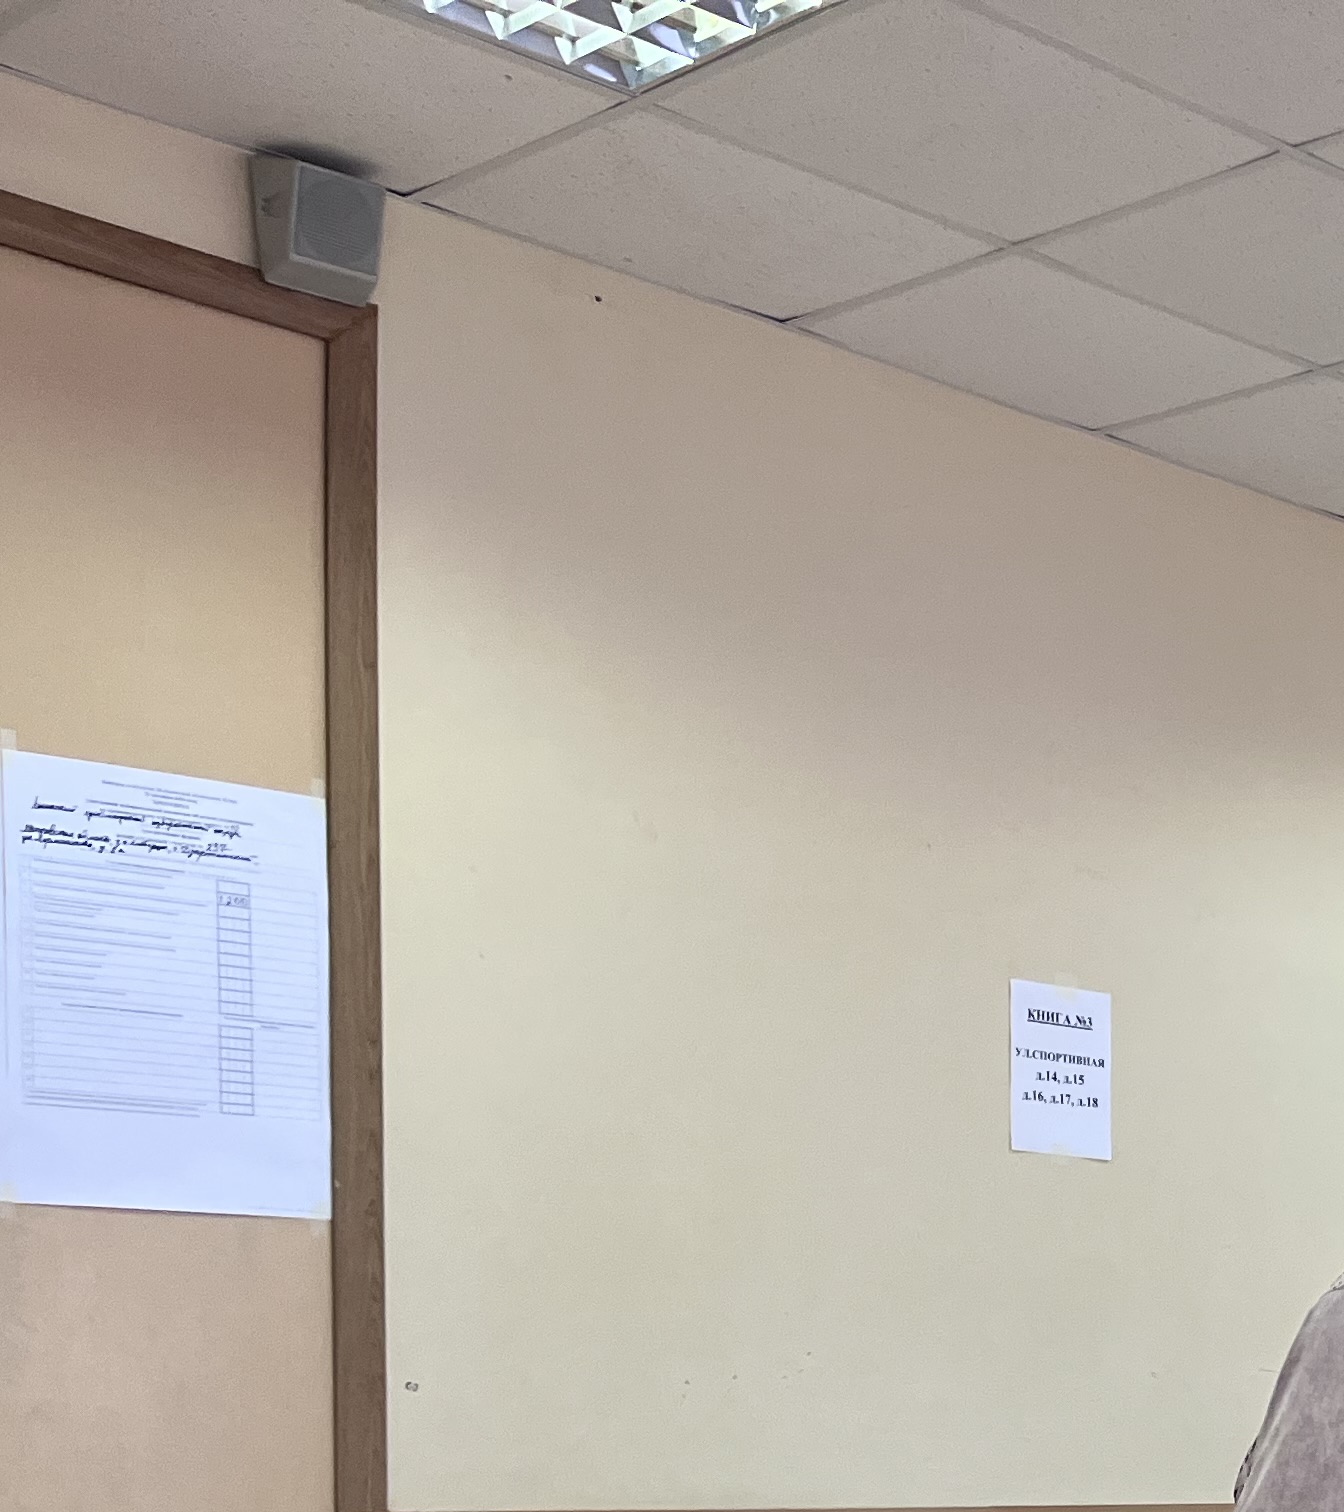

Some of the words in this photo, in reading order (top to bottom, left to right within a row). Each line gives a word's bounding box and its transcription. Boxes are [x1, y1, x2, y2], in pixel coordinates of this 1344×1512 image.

[1027, 1008, 1071, 1026] КНИГА
[1074, 1015, 1093, 1028] №3
[1015, 1047, 1105, 1068] УЛ.СПОРТИВНАЯ
[1036, 1071, 1060, 1084] д.14,
[1063, 1074, 1084, 1085] д.15
[1022, 1090, 1047, 1104] д.16,
[1050, 1094, 1074, 1107] д.17,
[1077, 1097, 1098, 1108] д.18
